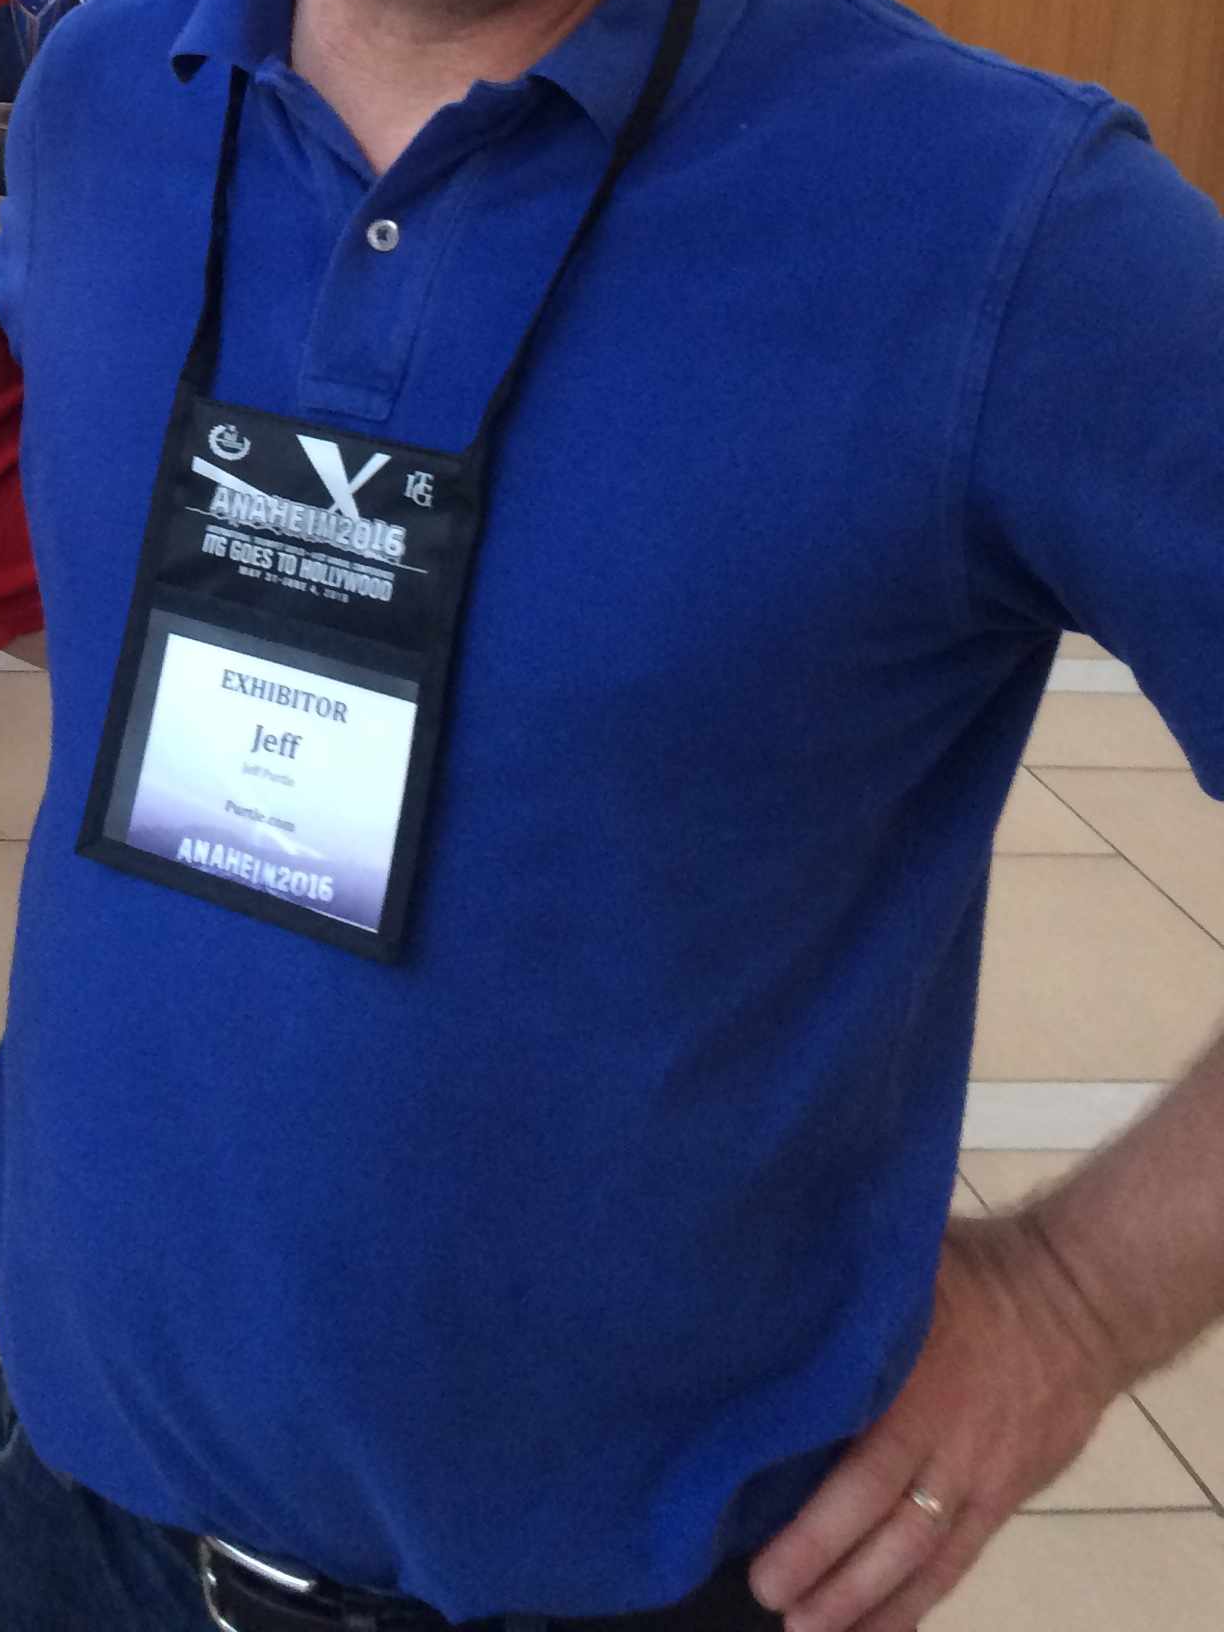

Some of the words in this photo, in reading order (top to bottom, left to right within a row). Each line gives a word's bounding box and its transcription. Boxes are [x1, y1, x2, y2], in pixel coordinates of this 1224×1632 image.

[208, 483, 408, 558] ANAHEIM2016
[229, 539, 274, 569] GOES
[277, 551, 298, 575] TO
[299, 557, 394, 602] HOLLYWOOD
[221, 668, 349, 723] EXHIBITOR
[250, 723, 304, 760] Jeff
[176, 837, 336, 903] ANAHEIM2016
